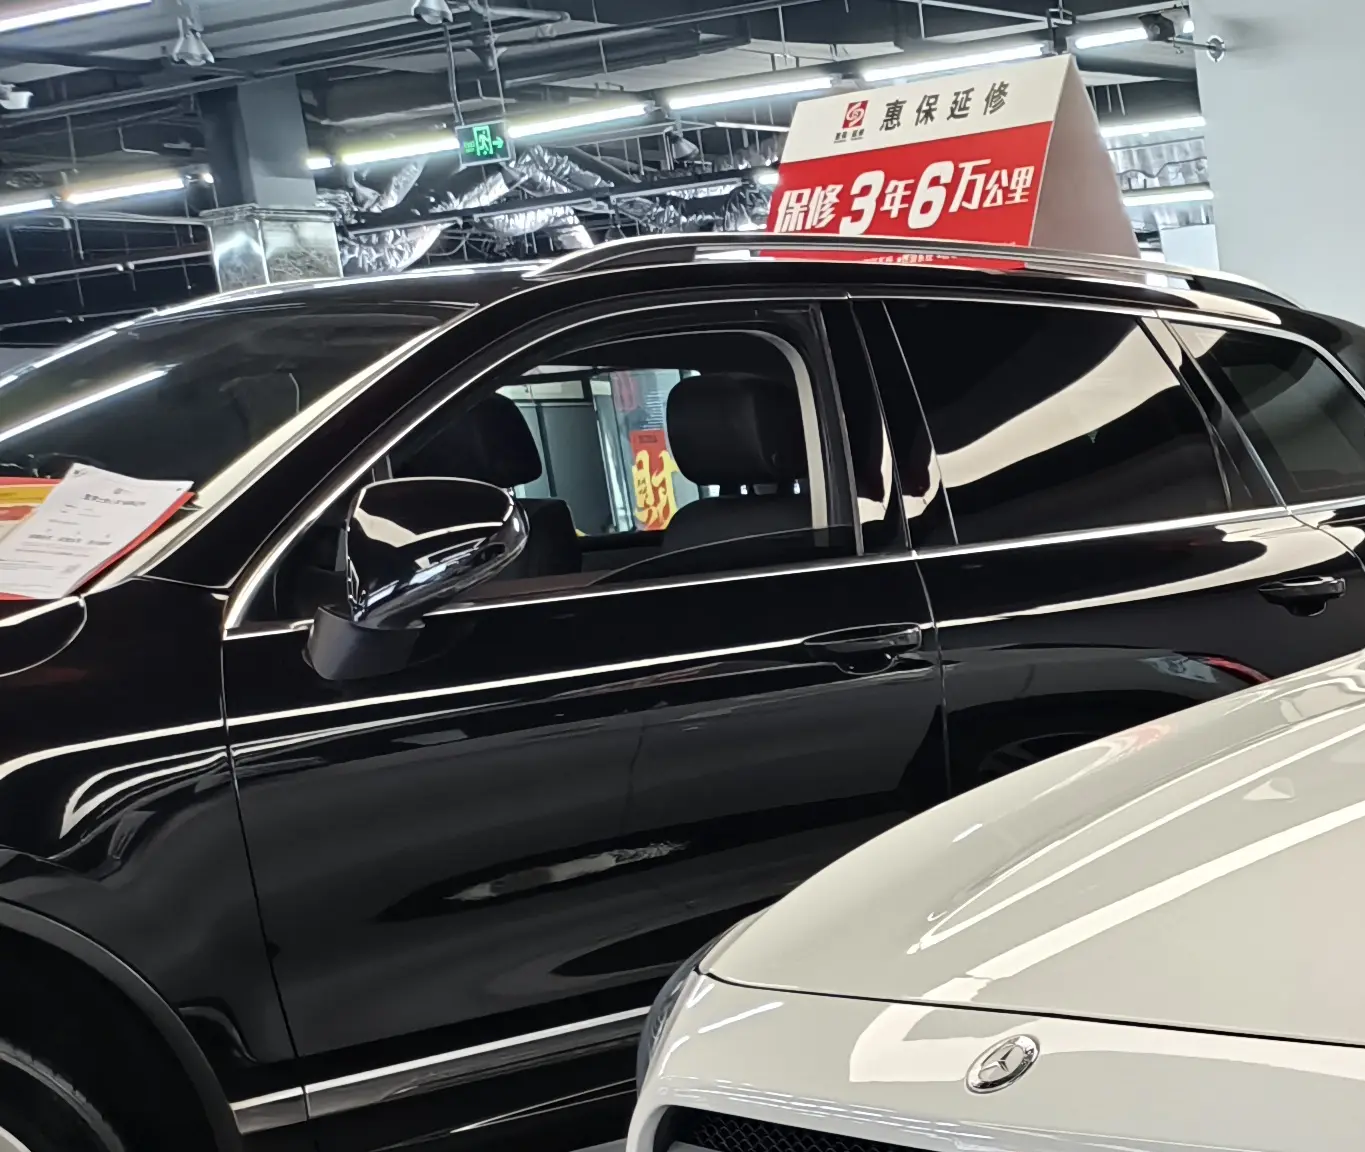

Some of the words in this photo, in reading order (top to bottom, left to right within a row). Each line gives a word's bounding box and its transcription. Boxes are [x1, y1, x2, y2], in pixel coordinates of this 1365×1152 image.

[879, 81, 1010, 131] 惠保延修
[774, 158, 1035, 236] 保修3年6万公里
